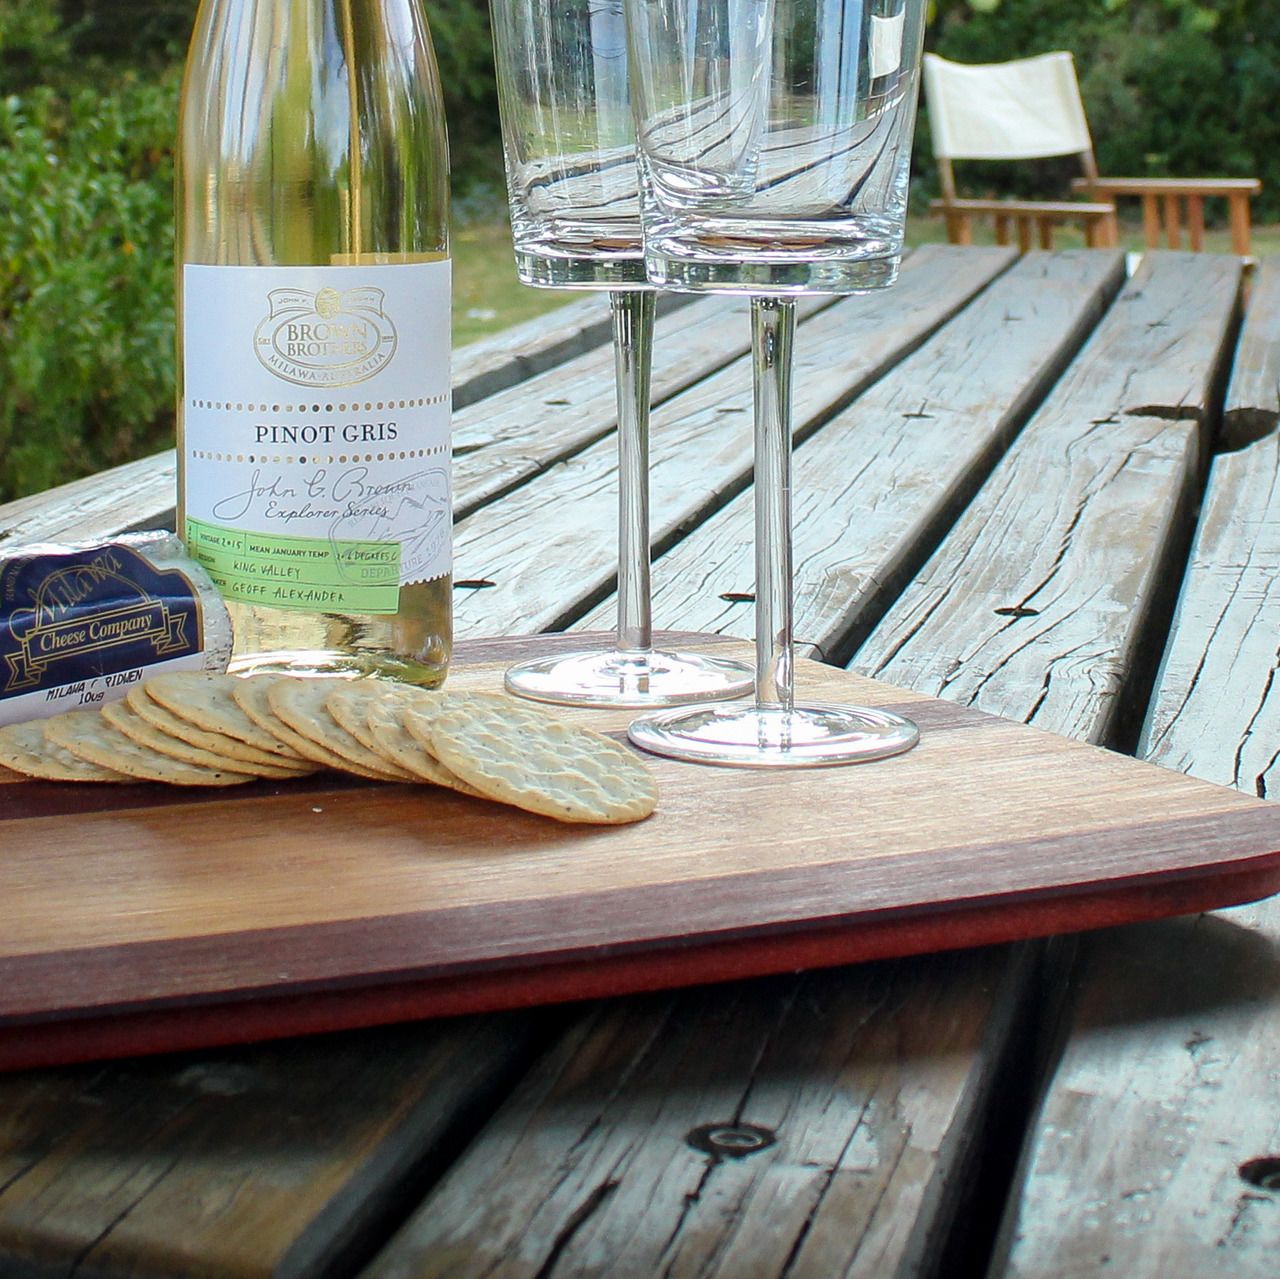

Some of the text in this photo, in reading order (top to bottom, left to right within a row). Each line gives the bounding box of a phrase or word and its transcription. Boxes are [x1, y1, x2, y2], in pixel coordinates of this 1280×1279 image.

[255, 422, 398, 444] PINOT GRIS
[212, 469, 297, 521] John
[331, 466, 415, 503] Brown
[264, 500, 339, 524] Explorer
[342, 500, 389, 519] Series
[222, 537, 243, 550] 2015
[249, 544, 271, 555] MEAN
[272, 547, 307, 558] JANUARY
[308, 550, 330, 559] TEMP
[354, 551, 390, 561] DEGREES
[233, 560, 301, 580] KING VALLEY
[9, 548, 122, 641] Milawa
[232, 581, 345, 602] GEOFF ALEXANDER
[40, 613, 153, 652] Cheese Company
[45, 682, 86, 701] MILAWA
